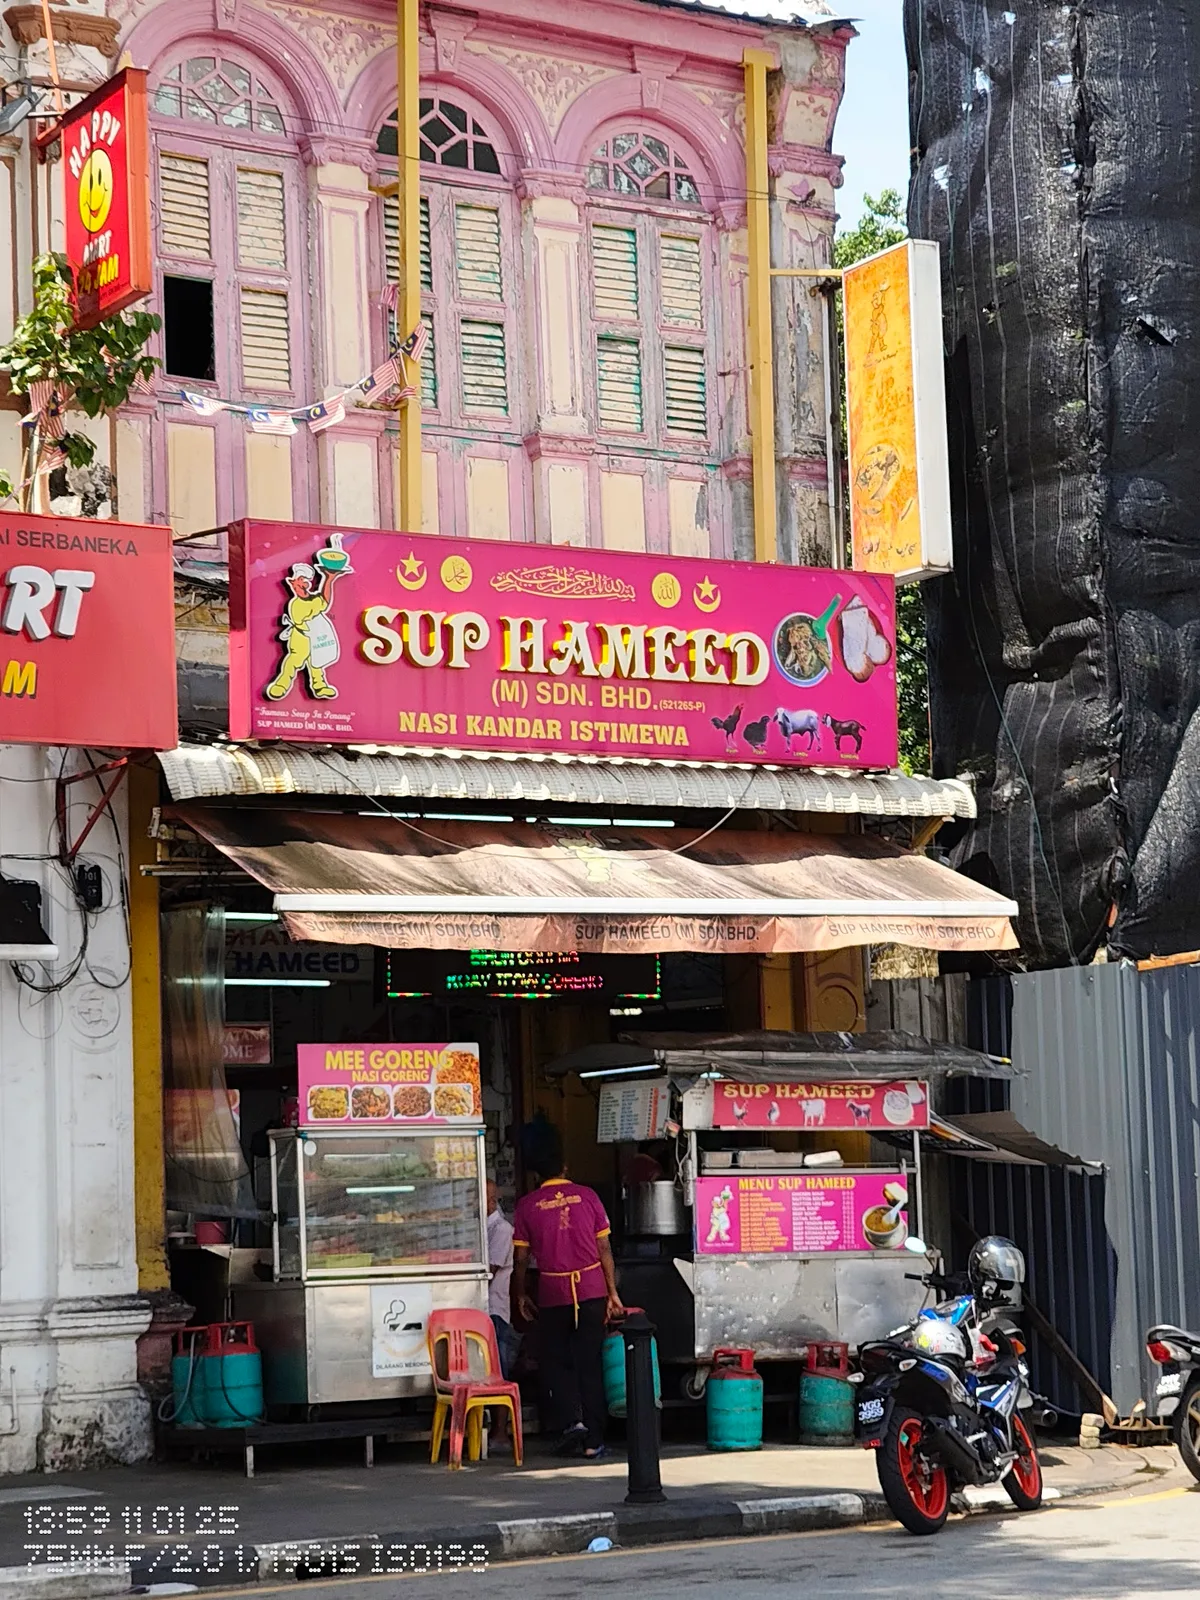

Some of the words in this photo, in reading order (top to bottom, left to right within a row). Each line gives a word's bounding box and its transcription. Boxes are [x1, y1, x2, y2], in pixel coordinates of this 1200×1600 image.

[69, 110, 121, 179] HAPPY
[93, 253, 119, 290] JAM
[16, 529, 139, 556] SERBANEKA
[361, 604, 490, 668] SUP
[497, 616, 770, 686] HAMEED
[491, 678, 528, 708] (M)
[535, 681, 593, 707] SDN.
[601, 685, 658, 710] BHD.
[291, 708, 310, 720] Soup
[257, 720, 272, 728] SUP
[274, 721, 304, 729] HAMEED
[336, 724, 354, 732] BHD.
[399, 711, 457, 735] NASI
[466, 715, 562, 740] KANDAR
[570, 720, 690, 746] ISTIMEWA
[575, 924, 605, 940] SUP
[608, 924, 671, 940] HAMEED
[674, 924, 695, 940] (M)
[829, 923, 856, 937] SUP
[861, 922, 914, 936] HAMEED
[916, 924, 936, 939] (M)
[236, 951, 360, 974] HAMEED
[325, 1050, 365, 1071] MEE
[369, 1049, 455, 1070] GORENG
[352, 1070, 379, 1082] NASI
[381, 1070, 429, 1082] GORENG
[723, 1083, 770, 1098] SUP
[775, 1083, 876, 1099] HAMEED
[738, 1178, 774, 1190] MENU
[778, 1178, 802, 1190] SUP
[806, 1177, 856, 1190] HAMEED
[375, 1362, 404, 1370] DILARANG
[858, 1407, 885, 1421] 3959
